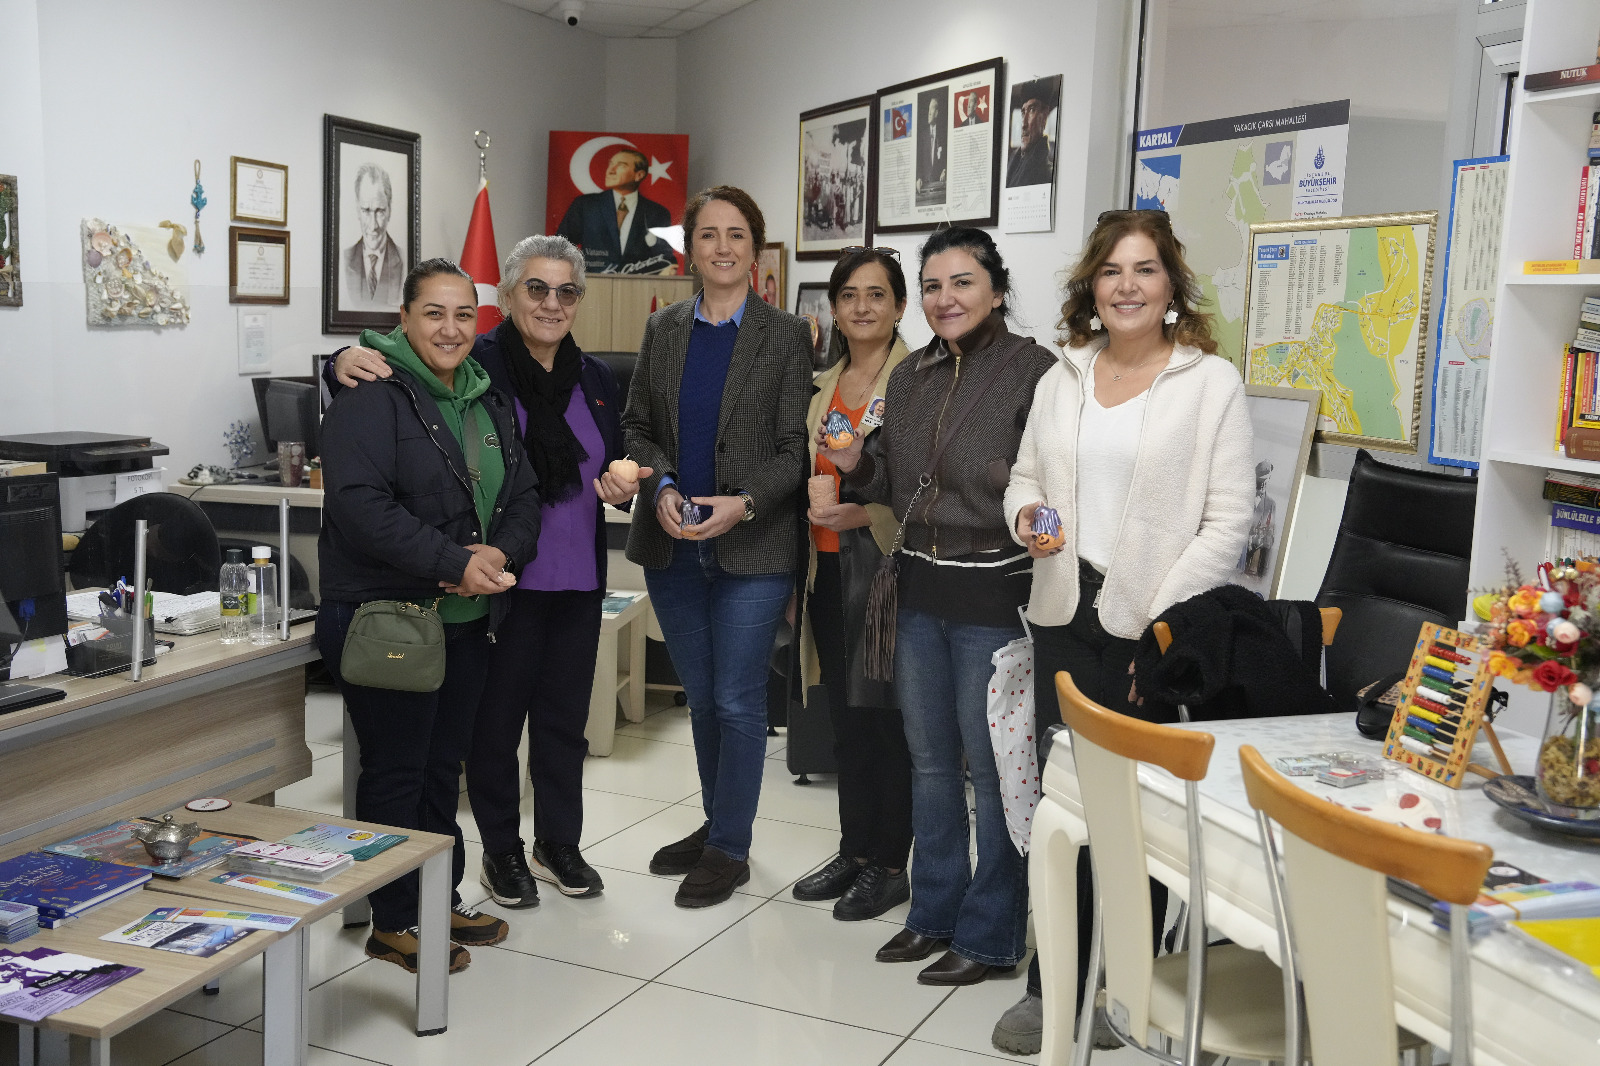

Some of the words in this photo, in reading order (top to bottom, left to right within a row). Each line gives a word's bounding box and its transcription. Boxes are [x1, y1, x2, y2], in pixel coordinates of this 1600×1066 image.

[1560, 67, 1588, 79] NUTUK
[1233, 121, 1257, 132] YAKACIK
[1257, 119, 1274, 131] ÇARŞI
[1275, 112, 1307, 127] MAHALLESİ
[1139, 131, 1173, 147] KARTAL
[1299, 175, 1337, 188] BÜYÜKŞEHİR
